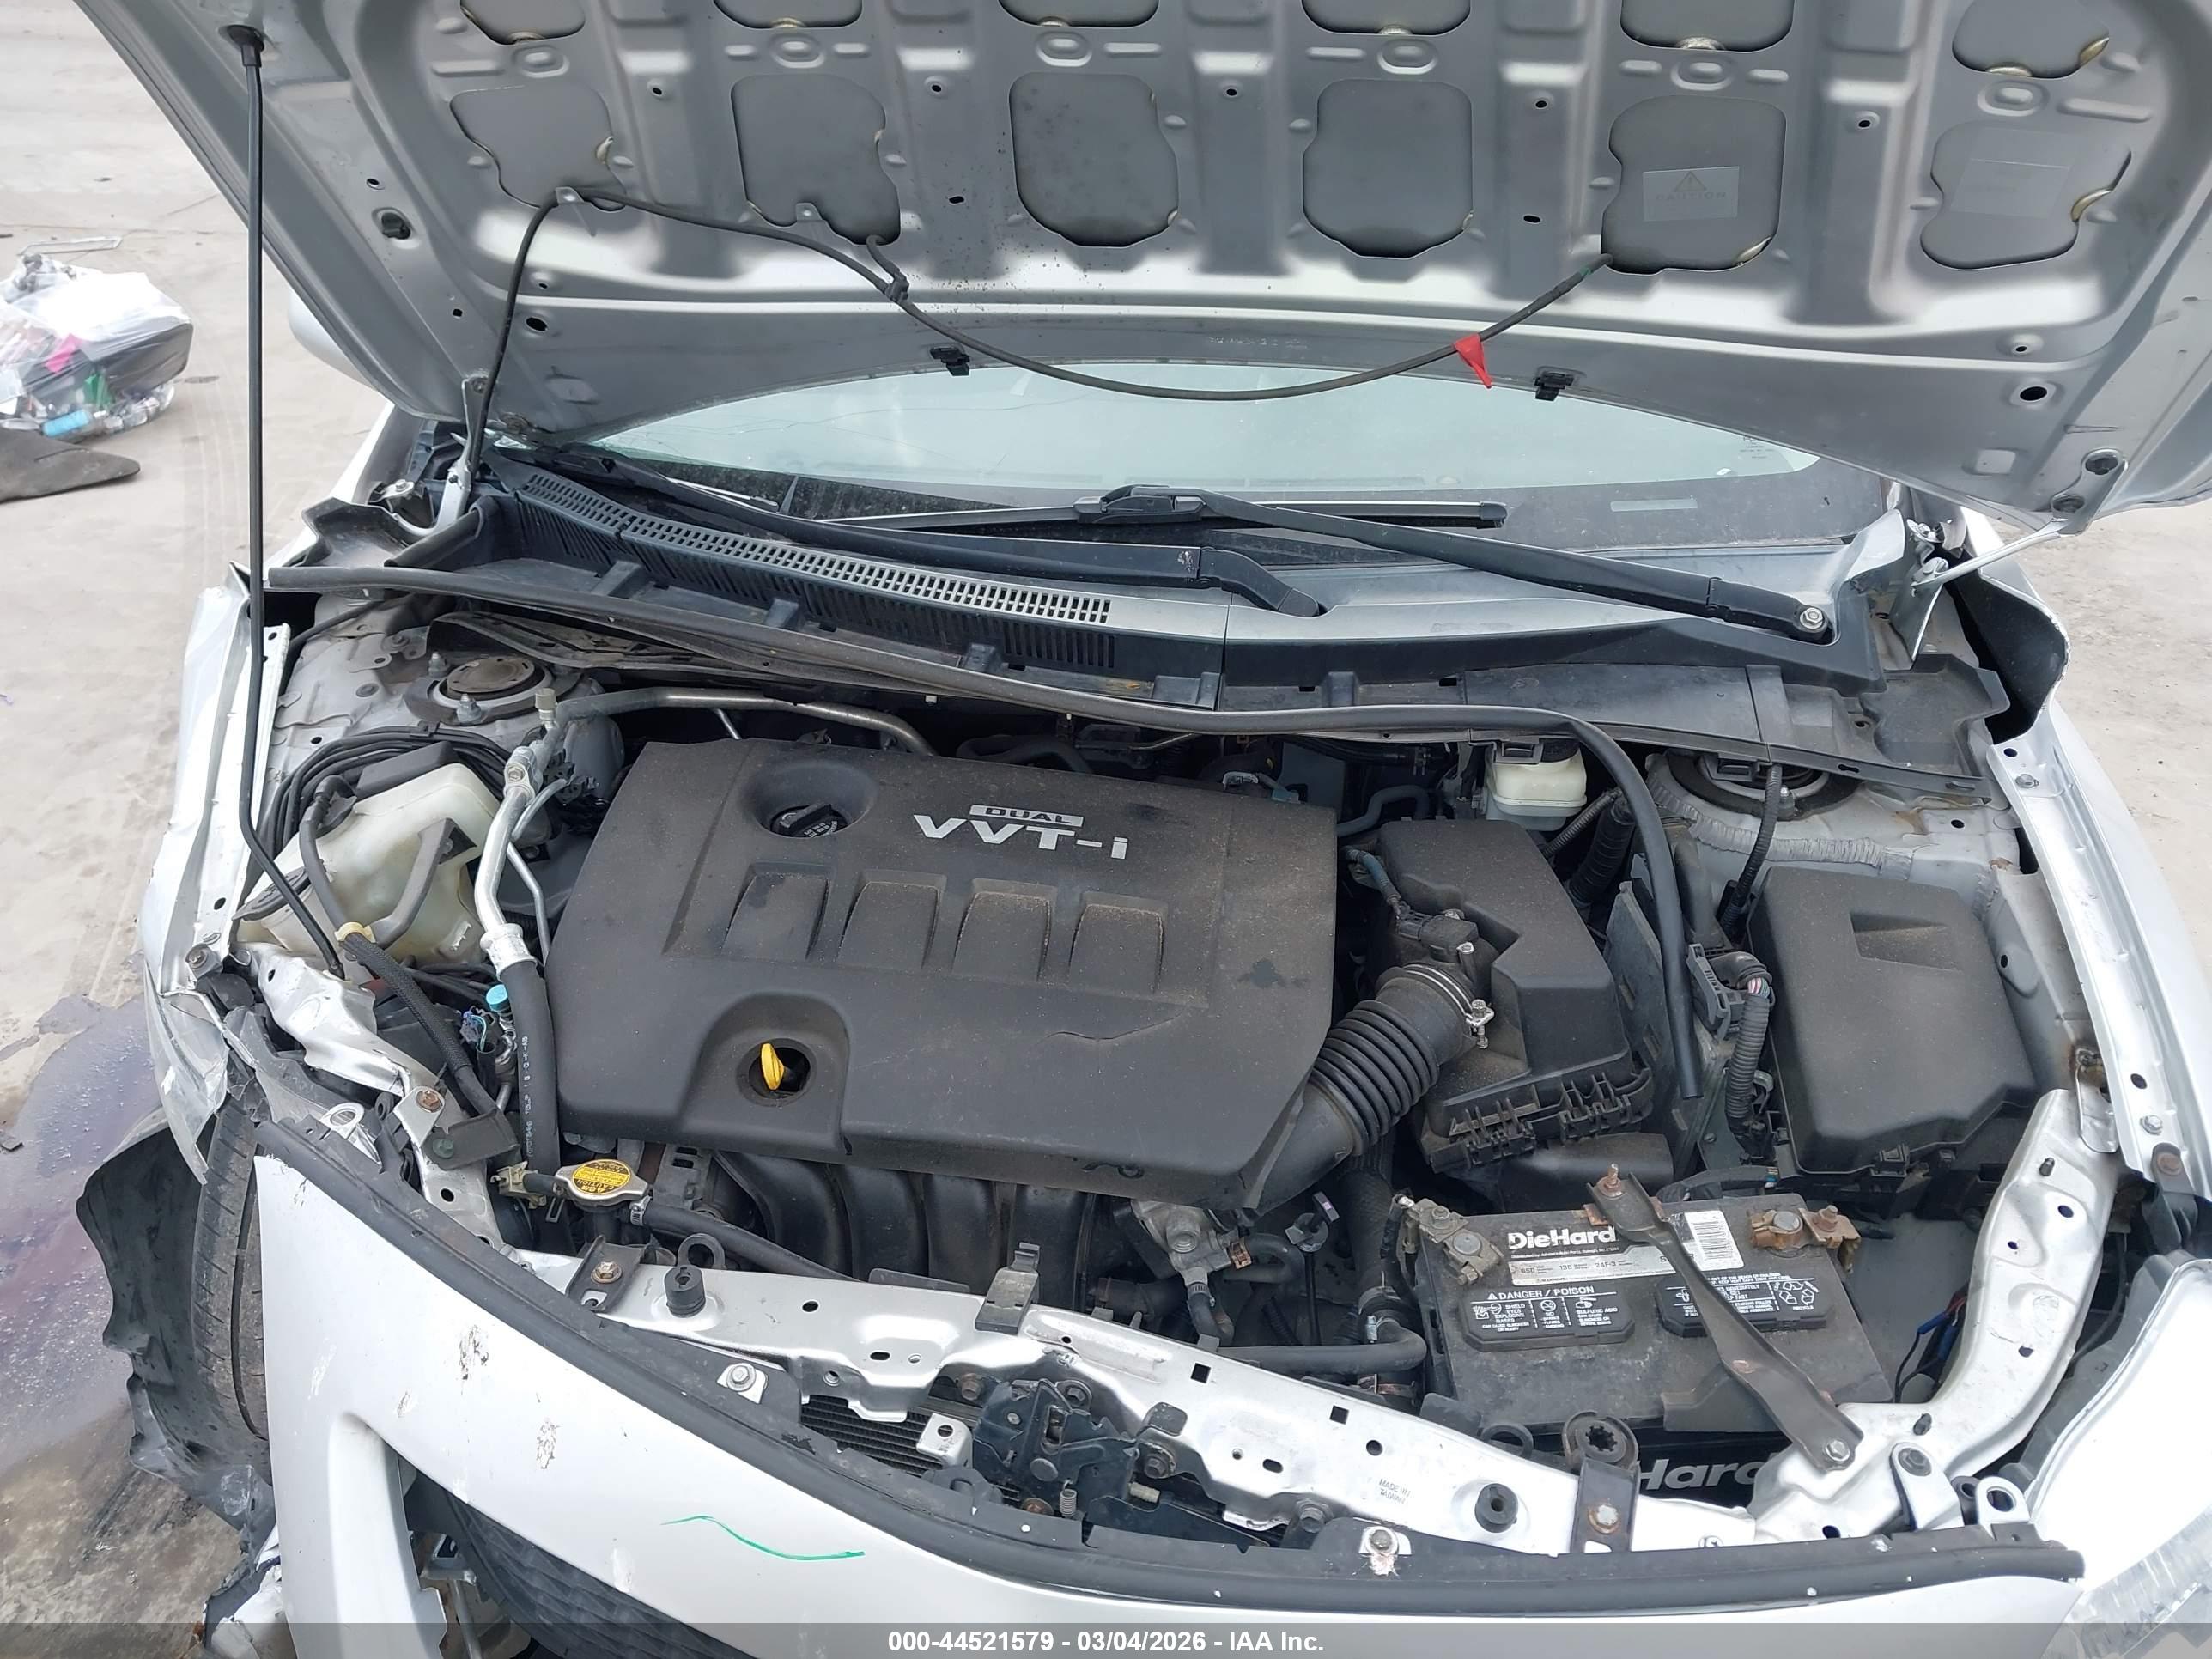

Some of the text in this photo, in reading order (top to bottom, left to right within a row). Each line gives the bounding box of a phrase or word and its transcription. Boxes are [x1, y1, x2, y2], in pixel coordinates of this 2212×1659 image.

[985, 807, 1073, 823] DUAL
[914, 814, 1128, 859] VVT-i
[576, 1179, 614, 1190] CAUTION
[1508, 1225, 1617, 1249] DieHard
[1498, 1290, 1543, 1300] DANGER
[1553, 1285, 1595, 1296] POISON
[1379, 1478, 1400, 1492] MADE
[1380, 1488, 1407, 1504] TAIWAN
